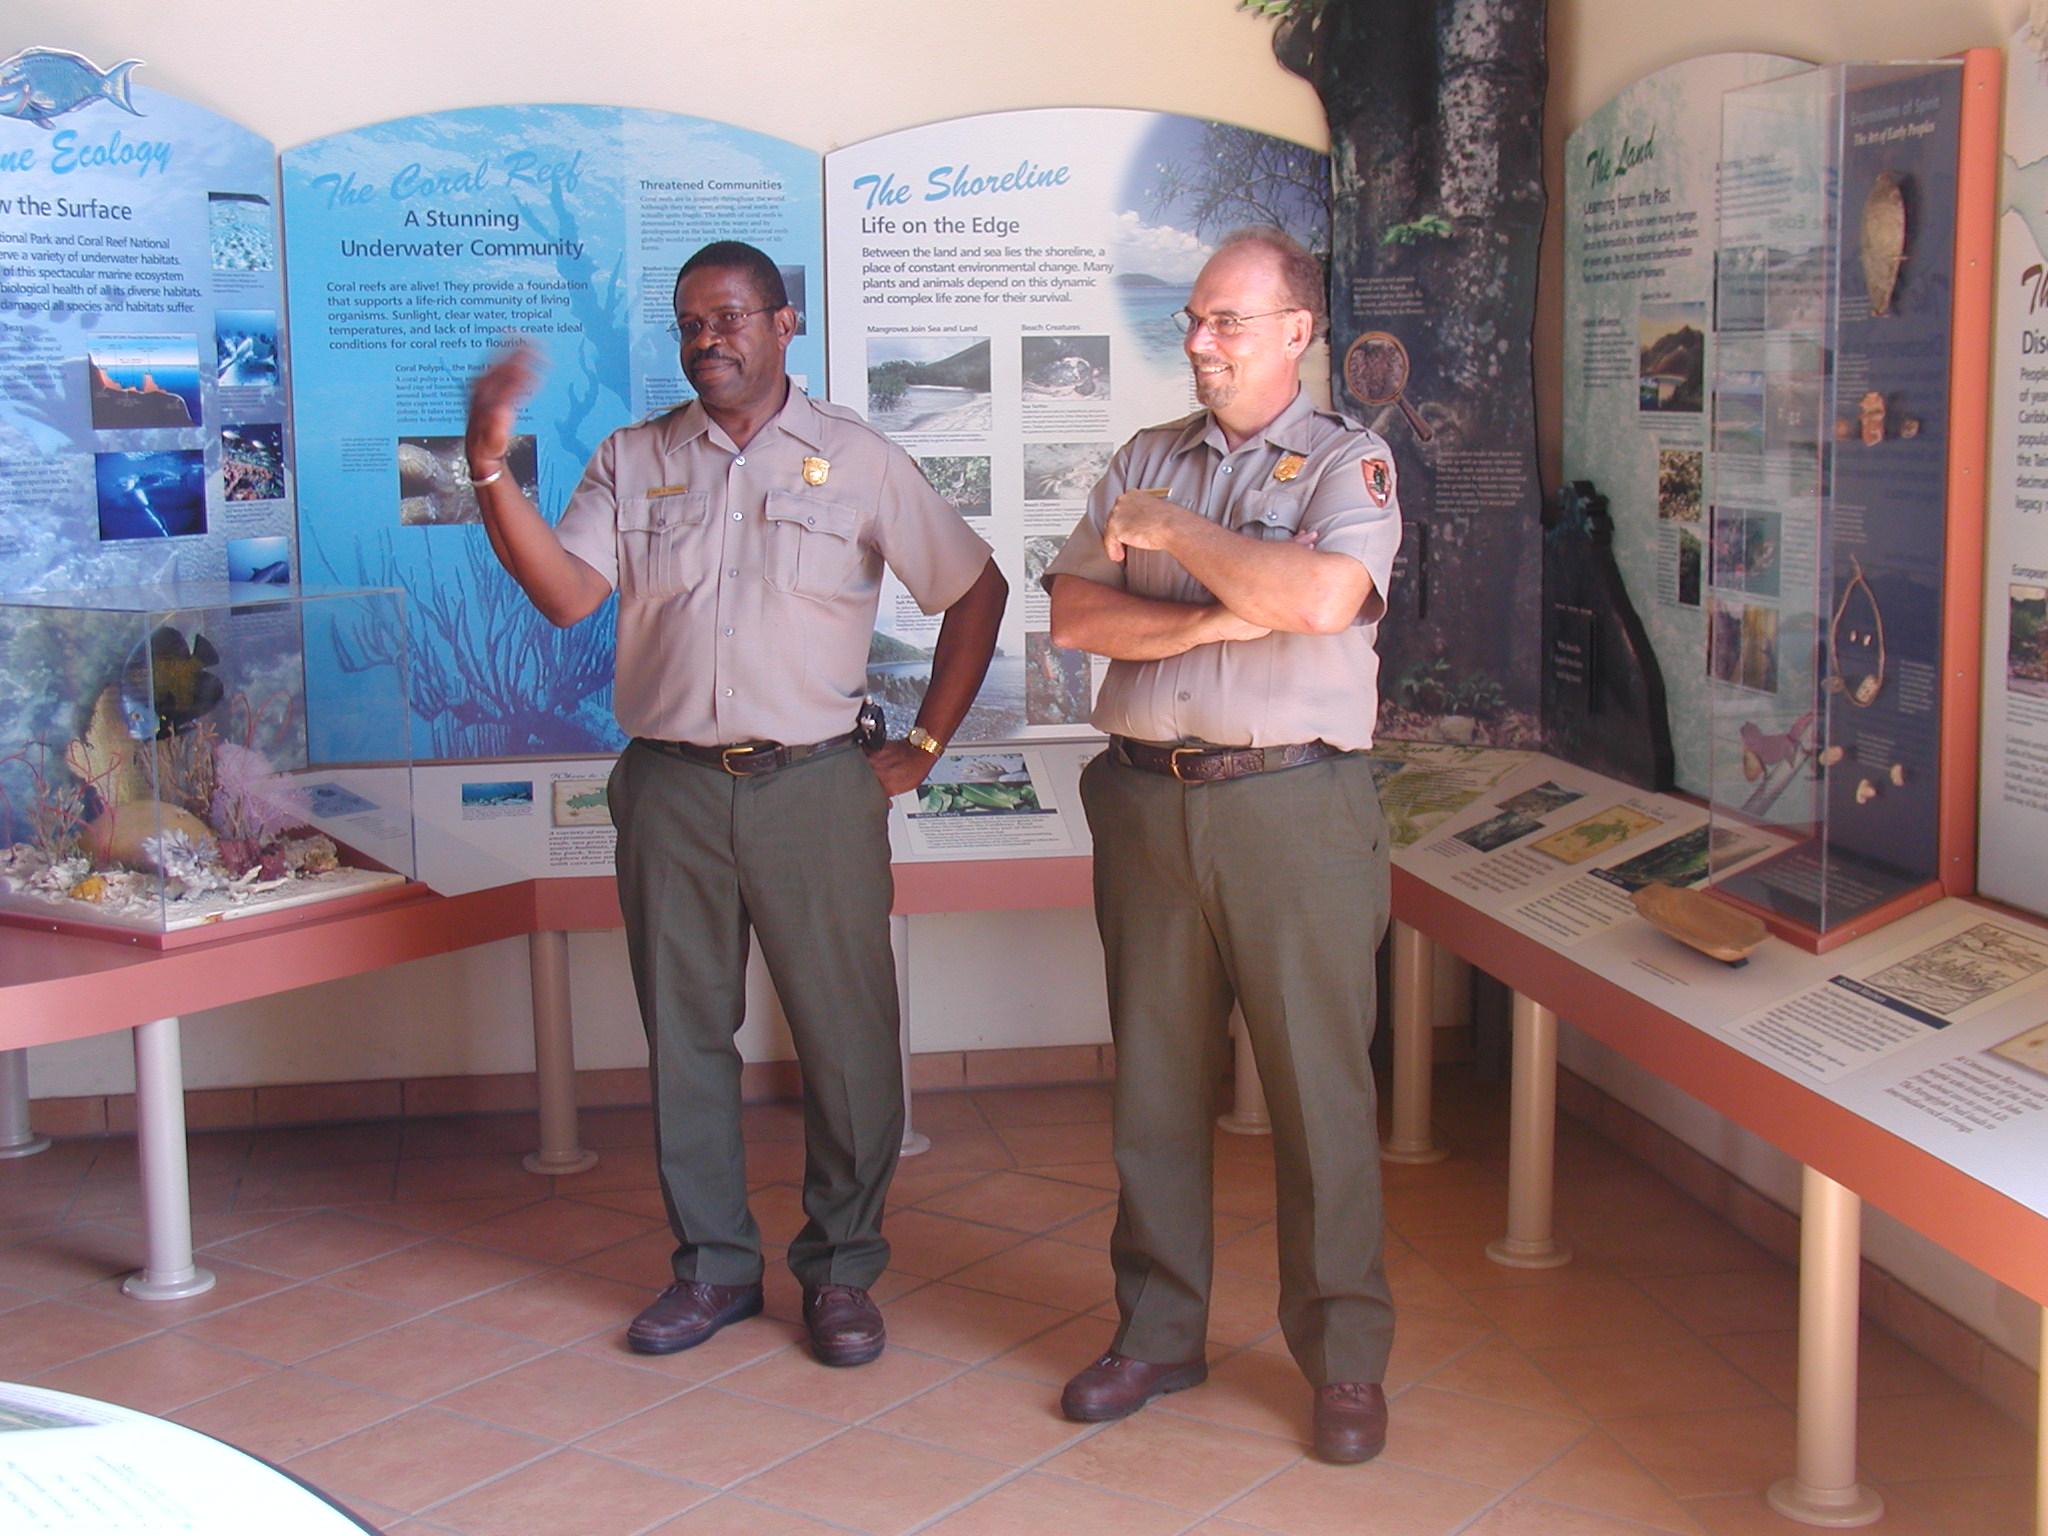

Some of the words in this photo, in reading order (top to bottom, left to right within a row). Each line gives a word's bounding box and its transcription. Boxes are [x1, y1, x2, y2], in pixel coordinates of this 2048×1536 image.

[50, 129, 171, 177] Ecology
[1615, 125, 1657, 177] Land
[311, 171, 374, 210] The
[390, 162, 489, 201] Coral
[504, 150, 585, 193] Reef
[640, 180, 704, 191] Threatened
[708, 179, 783, 191] Communities
[853, 173, 912, 211] The
[924, 160, 1072, 202] Shoreline
[17, 195, 52, 216] the
[57, 197, 132, 220] Surface
[404, 210, 420, 227] A
[426, 209, 520, 231] Stunning
[861, 217, 896, 234] Life
[902, 221, 927, 234] on
[934, 217, 965, 234] the
[972, 217, 1020, 237] Edge
[30, 233, 53, 245] Park
[55, 234, 75, 246] and
[77, 234, 104, 247] Coral
[105, 236, 129, 248] Reef
[130, 237, 170, 249] National
[340, 239, 464, 257] Underwater
[470, 239, 584, 259] Community
[862, 247, 910, 258] Between
[912, 247, 931, 258] the
[934, 247, 957, 258] land
[960, 247, 981, 258] and
[983, 249, 1001, 257] sea
[1004, 247, 1023, 258] lies
[1025, 246, 1043, 257] the
[1045, 246, 1096, 258] shoreline,
[1098, 249, 1106, 257] a
[21, 252, 28, 260] a
[31, 249, 66, 264] variety
[67, 250, 79, 262] of
[81, 251, 139, 264] underwater
[141, 253, 182, 266] habitats.
[3, 264, 15, 277] of
[17, 265, 37, 277] this
[39, 267, 95, 280] spectacular
[98, 268, 132, 280] marine
[134, 270, 184, 283] ecosystem
[862, 262, 891, 275] place
[894, 261, 907, 273] of
[908, 262, 955, 273] constant
[958, 261, 1036, 272] environmental
[1039, 261, 1081, 275] change.
[1083, 261, 1114, 274] Many
[0, 282, 50, 297] biological
[52, 283, 84, 295] health
[86, 283, 98, 295] of
[100, 284, 112, 296] all
[113, 284, 125, 296] its
[127, 285, 161, 297] diverse
[163, 285, 203, 298] habitats.
[327, 281, 356, 293] Coral
[359, 281, 386, 292] reefs
[390, 283, 408, 292] are
[410, 280, 440, 292] alive!
[443, 280, 470, 294] They
[472, 280, 514, 293] provide
[517, 283, 525, 291] a
[527, 279, 588, 291] foundation
[863, 277, 896, 290] plants
[899, 277, 920, 288] and
[923, 277, 964, 288] animals
[967, 276, 1008, 290] depend
[1011, 279, 1026, 288] on
[1028, 276, 1049, 288] this
[1051, 276, 1096, 289] dynamic
[327, 296, 351, 306] that
[354, 296, 402, 309] supports
[415, 295, 457, 306] life-rich
[460, 295, 523, 308] community
[526, 294, 538, 305] of
[540, 294, 570, 308] living
[863, 292, 884, 304] and
[887, 292, 933, 306] complex
[935, 292, 952, 304] life
[954, 294, 981, 304] zone
[983, 291, 1000, 303] for
[1002, 291, 1027, 303] their
[1029, 291, 1072, 303] survival.
[0, 300, 50, 313] damaged
[52, 300, 64, 311] all
[66, 301, 101, 314] species
[104, 300, 124, 312] and
[126, 301, 164, 313] habitats
[328, 309, 389, 323] organisms.
[392, 309, 441, 323] Sunlight,
[444, 309, 471, 321] clear
[473, 311, 508, 322] water,
[511, 309, 552, 322] tropical
[329, 325, 407, 338] temperatures,
[410, 324, 432, 335] and
[434, 324, 457, 335] lack
[459, 323, 472, 335] of
[474, 323, 517, 337] impacts
[520, 324, 554, 334] create
[556, 322, 584, 334] ideal
[867, 325, 909, 335] Mangroves
[911, 324, 926, 333] Join
[927, 324, 941, 333] Sea
[943, 324, 958, 332] and
[959, 324, 978, 333] Land
[1021, 323, 1044, 331] Beach
[1045, 323, 1081, 331] Creatures
[329, 338, 387, 351] conditions
[390, 338, 407, 350] for
[410, 338, 437, 350] coral
[440, 338, 467, 349] reefs
[470, 339, 483, 349] to
[395, 364, 417, 373] Coral
[452, 363, 466, 371] the
